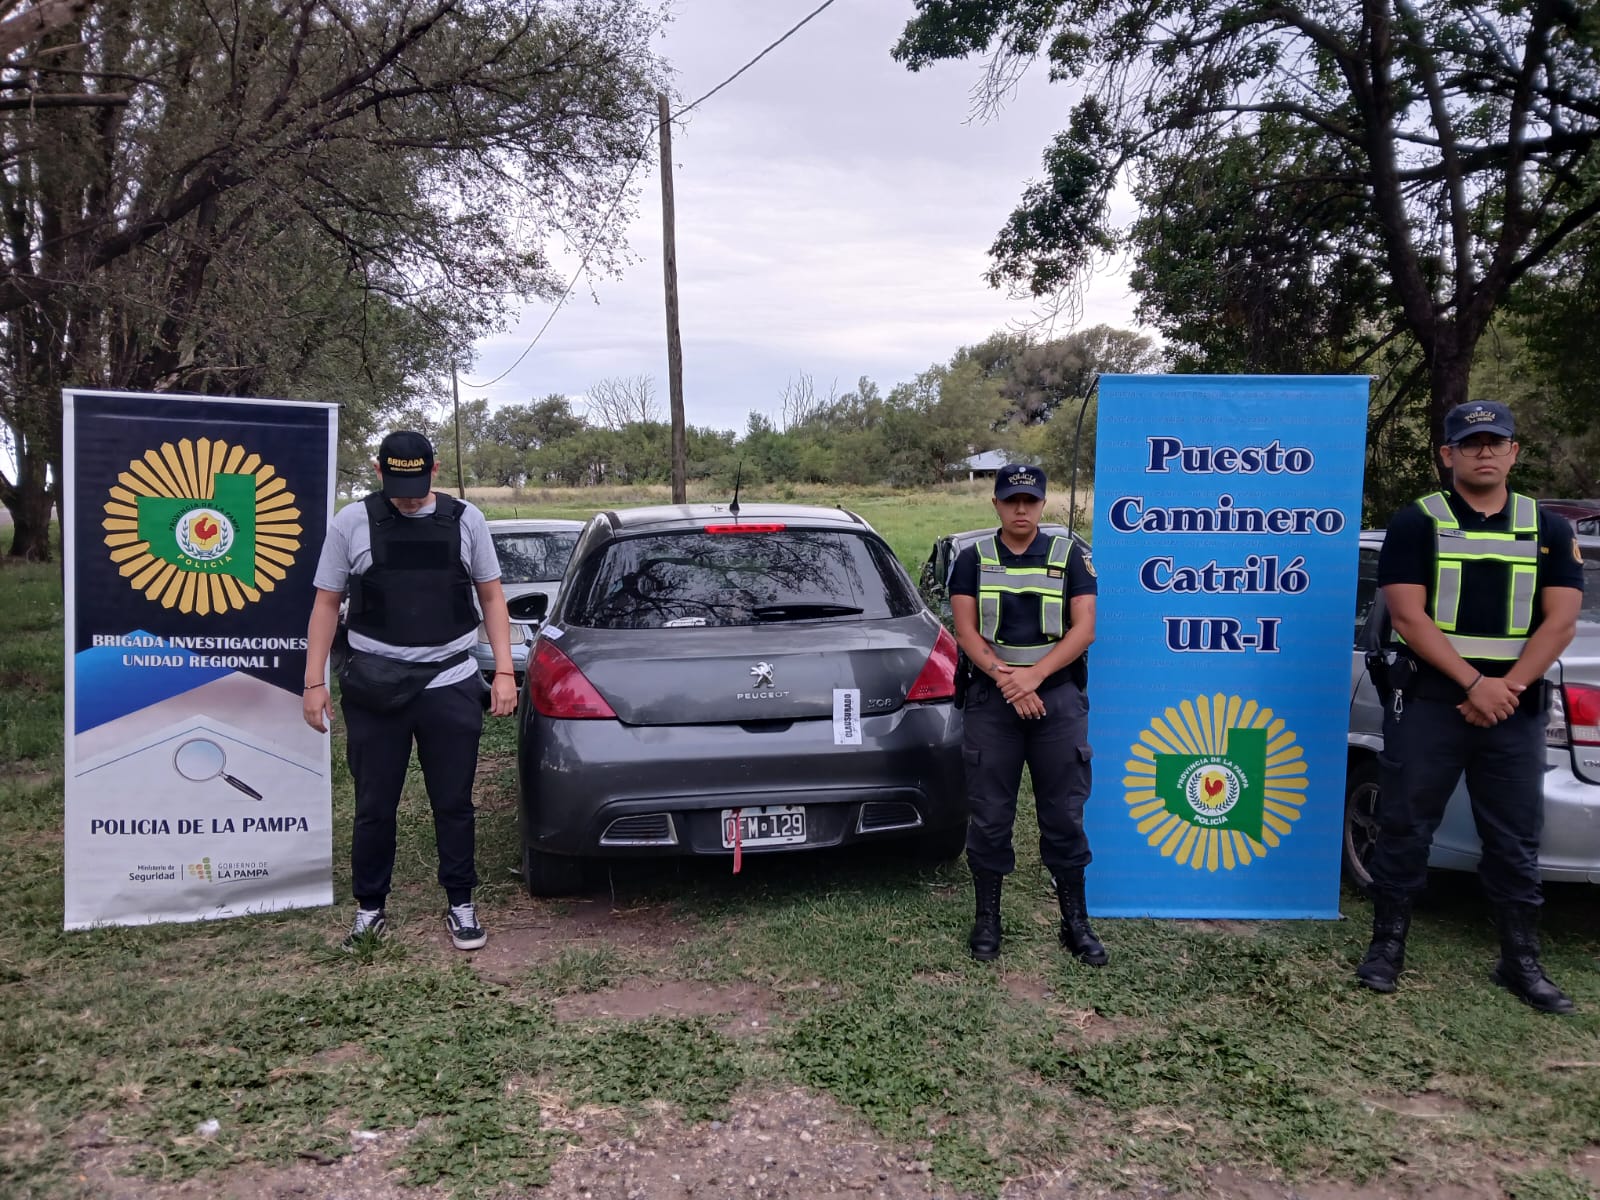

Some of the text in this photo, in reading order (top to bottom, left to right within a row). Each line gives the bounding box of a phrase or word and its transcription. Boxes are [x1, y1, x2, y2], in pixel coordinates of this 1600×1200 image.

[387, 457, 425, 467] BRIGADA
[1145, 436, 1315, 475] Puesto
[1108, 494, 1346, 535] Caminero
[177, 553, 232, 569] POLICIA
[1139, 554, 1310, 595] Catriló
[92, 634, 308, 650] BRIGADA INVESTIGACIONES
[1162, 616, 1282, 653] UR-I
[122, 654, 280, 669] UNIDAD REGIONAL I
[737, 691, 790, 700] PEUGEOT
[1177, 758, 1209, 789] PROVINCIA
[1223, 758, 1233, 767] LA
[1233, 764, 1249, 789] PAMPA
[91, 817, 309, 835] POLICIA DE LA PAMPA
[217, 861, 268, 870] GOBIERNO DE
[217, 868, 270, 879] LA PAMPA
[129, 872, 175, 883] Seguridad
